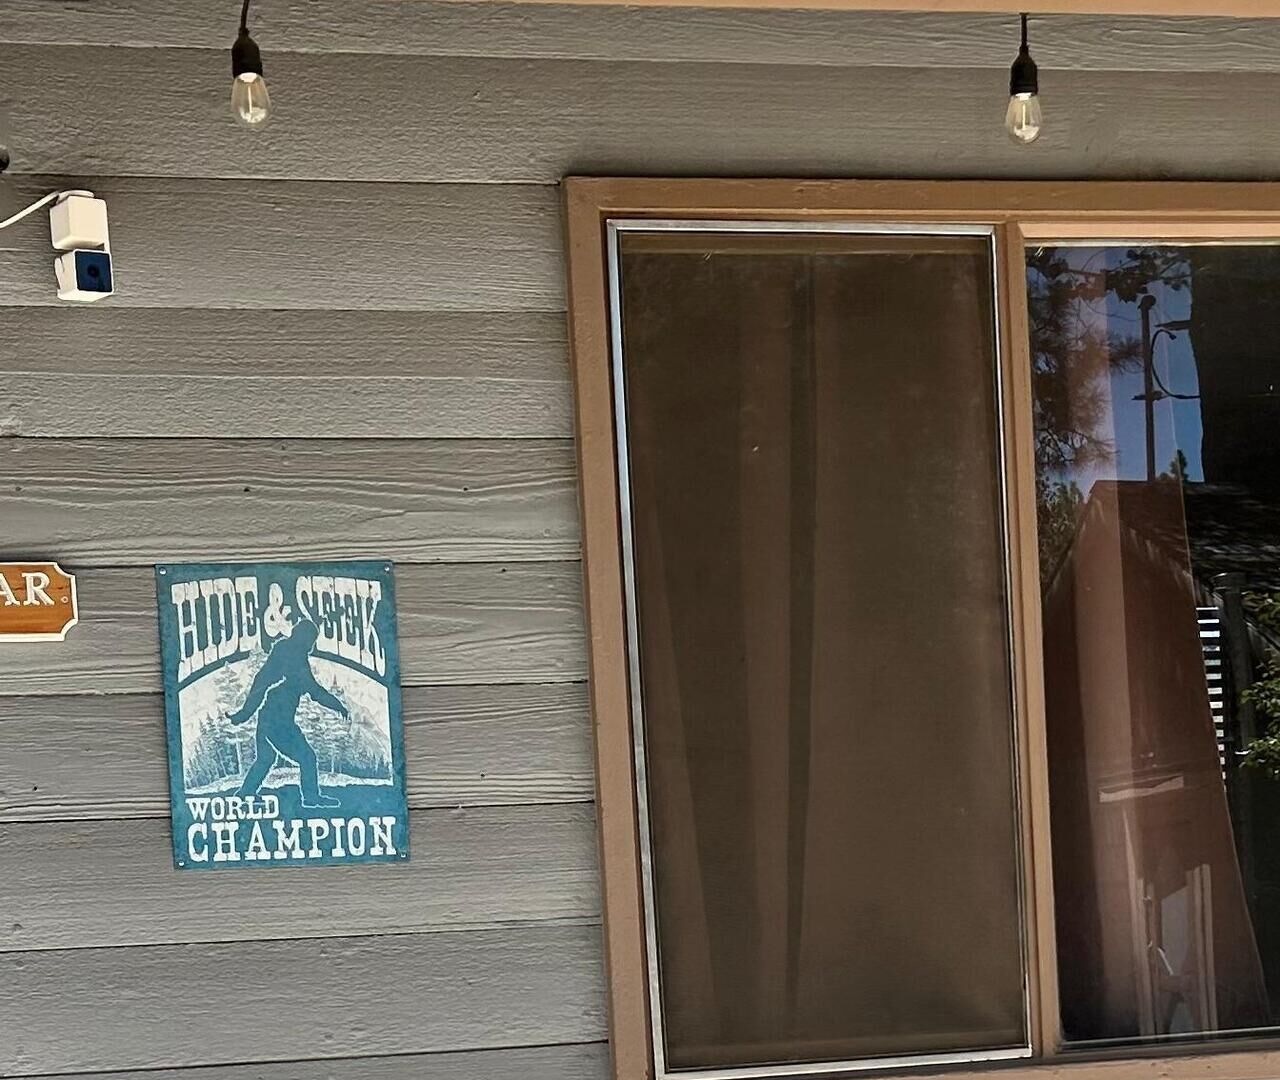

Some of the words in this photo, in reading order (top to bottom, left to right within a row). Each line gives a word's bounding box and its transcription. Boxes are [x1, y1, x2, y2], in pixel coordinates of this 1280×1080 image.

[171, 576, 264, 683] HIDE
[264, 583, 293, 637] &
[295, 576, 386, 677] SEEK
[186, 795, 279, 821] WORLD
[187, 816, 397, 862] CHAMPION
